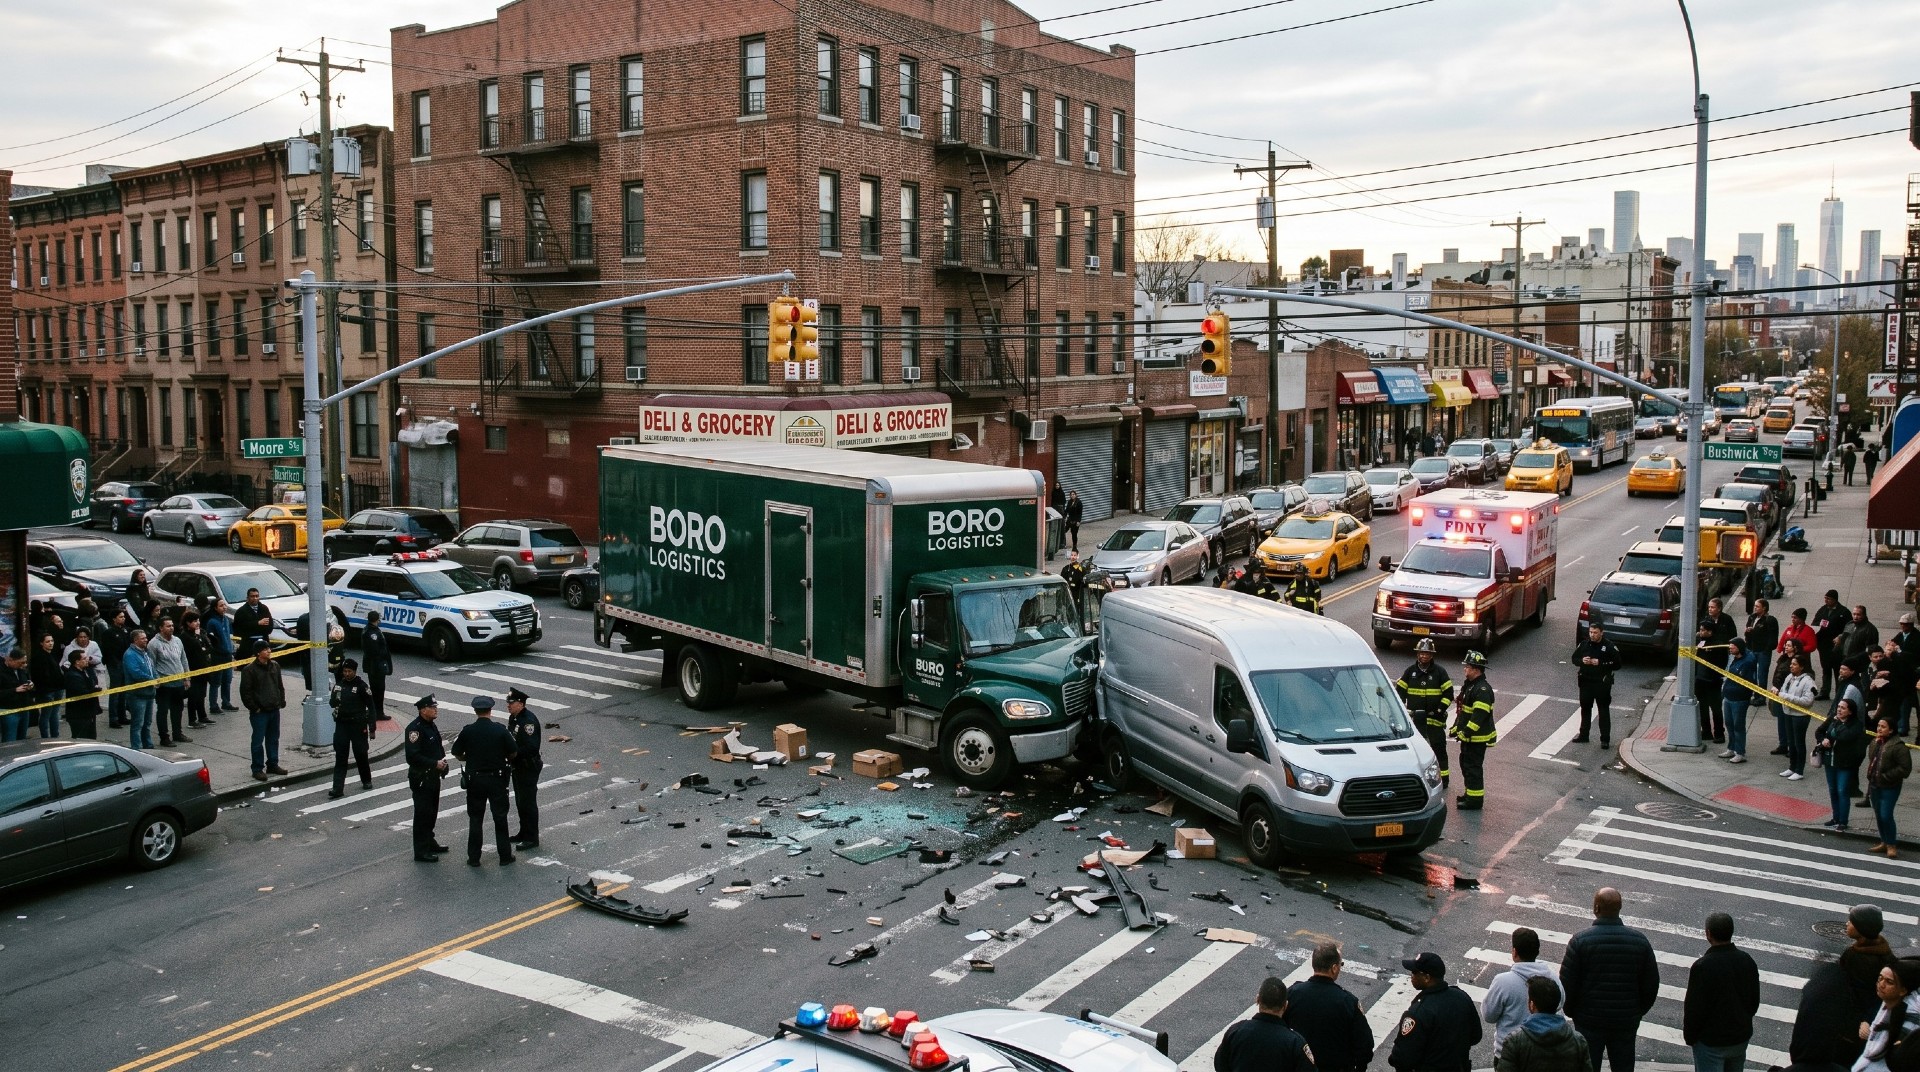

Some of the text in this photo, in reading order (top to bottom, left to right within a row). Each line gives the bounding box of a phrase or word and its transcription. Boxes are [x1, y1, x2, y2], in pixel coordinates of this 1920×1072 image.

[644, 410, 776, 437] DELI & GROCERY
[836, 408, 948, 436] DELI & GROCERY
[249, 441, 284, 455] Moore
[1708, 445, 1759, 460] Bushwick
[650, 505, 726, 555] BORO
[928, 507, 1005, 536] BORO
[1445, 520, 1487, 536] FDNY
[928, 534, 1004, 551] LOGISTICS
[649, 546, 726, 580] LOGISTICS
[382, 605, 416, 625] NYPD
